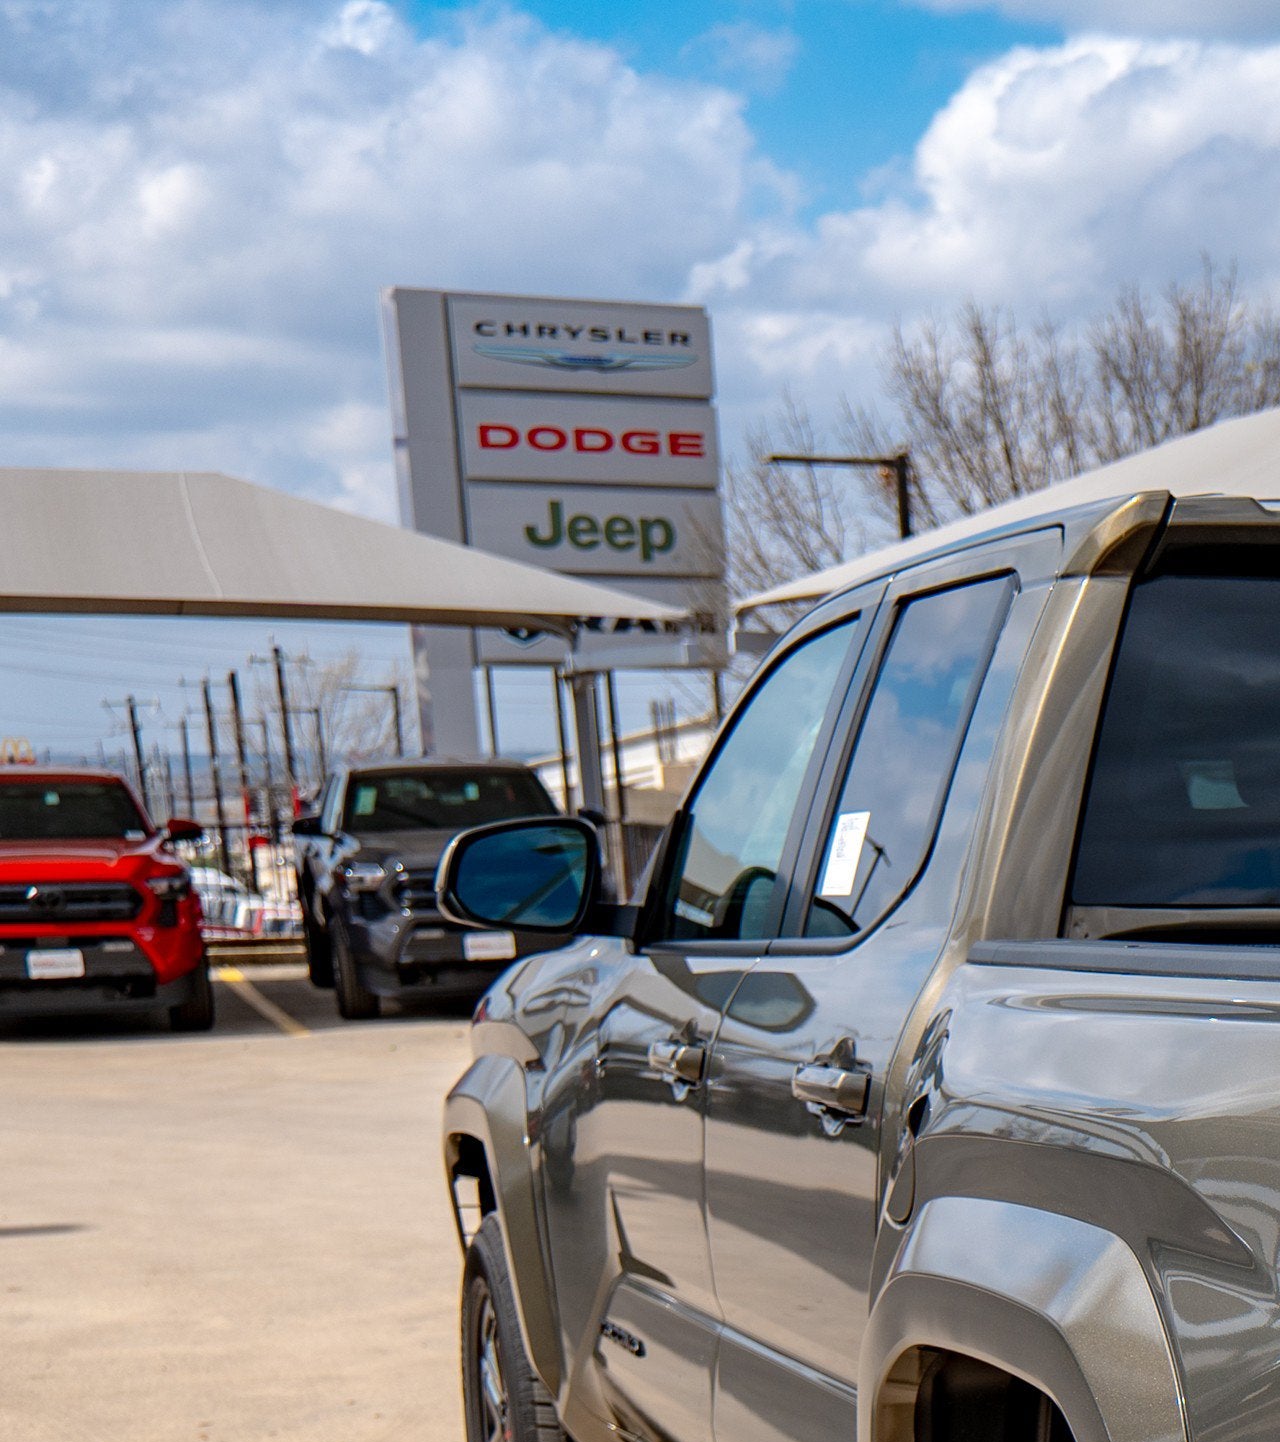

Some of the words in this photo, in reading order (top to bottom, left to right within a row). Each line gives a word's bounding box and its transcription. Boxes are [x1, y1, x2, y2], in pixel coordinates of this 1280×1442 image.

[474, 318, 692, 347] CHRYSLER
[478, 423, 706, 458] DODGE
[524, 500, 676, 562] Jeep
